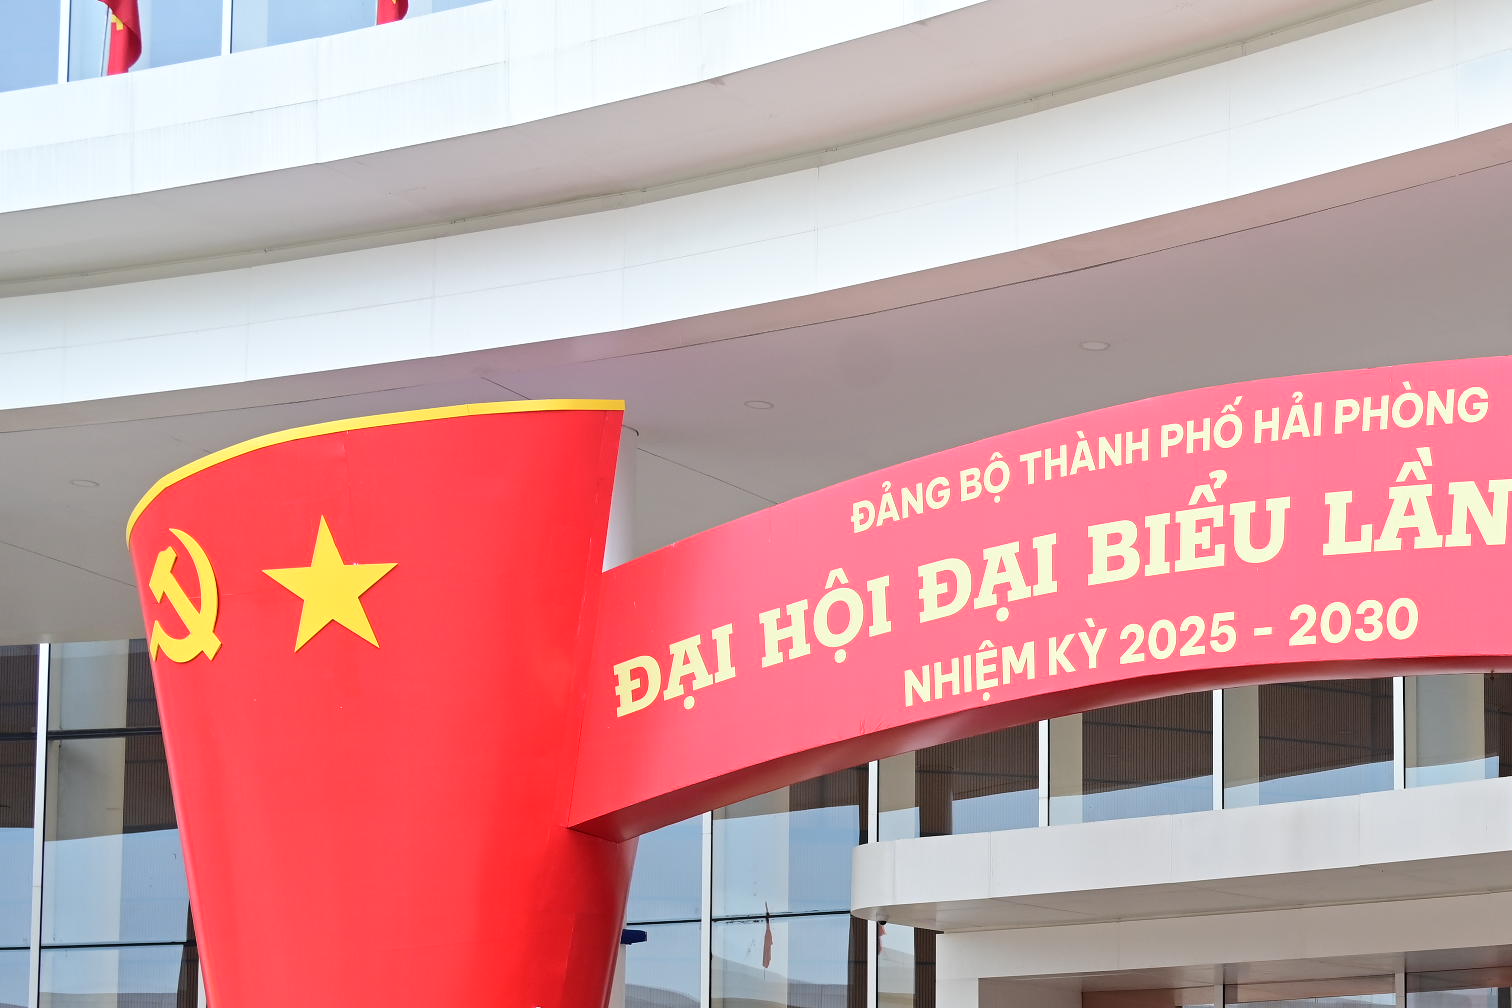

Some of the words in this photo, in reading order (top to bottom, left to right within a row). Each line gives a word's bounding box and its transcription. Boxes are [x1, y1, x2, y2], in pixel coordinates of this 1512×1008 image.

[850, 477, 952, 535] ĐẢNG
[960, 452, 1011, 504] BỘ
[1019, 429, 1149, 485] THÀNH
[1161, 395, 1243, 458] PHỐ
[1254, 391, 1323, 444] HẢI
[1335, 381, 1489, 435] PHÒNG
[613, 623, 737, 718] ĐẠI
[759, 567, 893, 668] HỘI
[918, 533, 1058, 623] ĐẠI
[1087, 469, 1291, 586] BIỂU
[904, 640, 1036, 707] NHIỆM
[1049, 617, 1108, 676] KỲ
[1119, 611, 1237, 665] 2025
[1254, 626, 1273, 636] -
[1289, 597, 1419, 646] 2030
